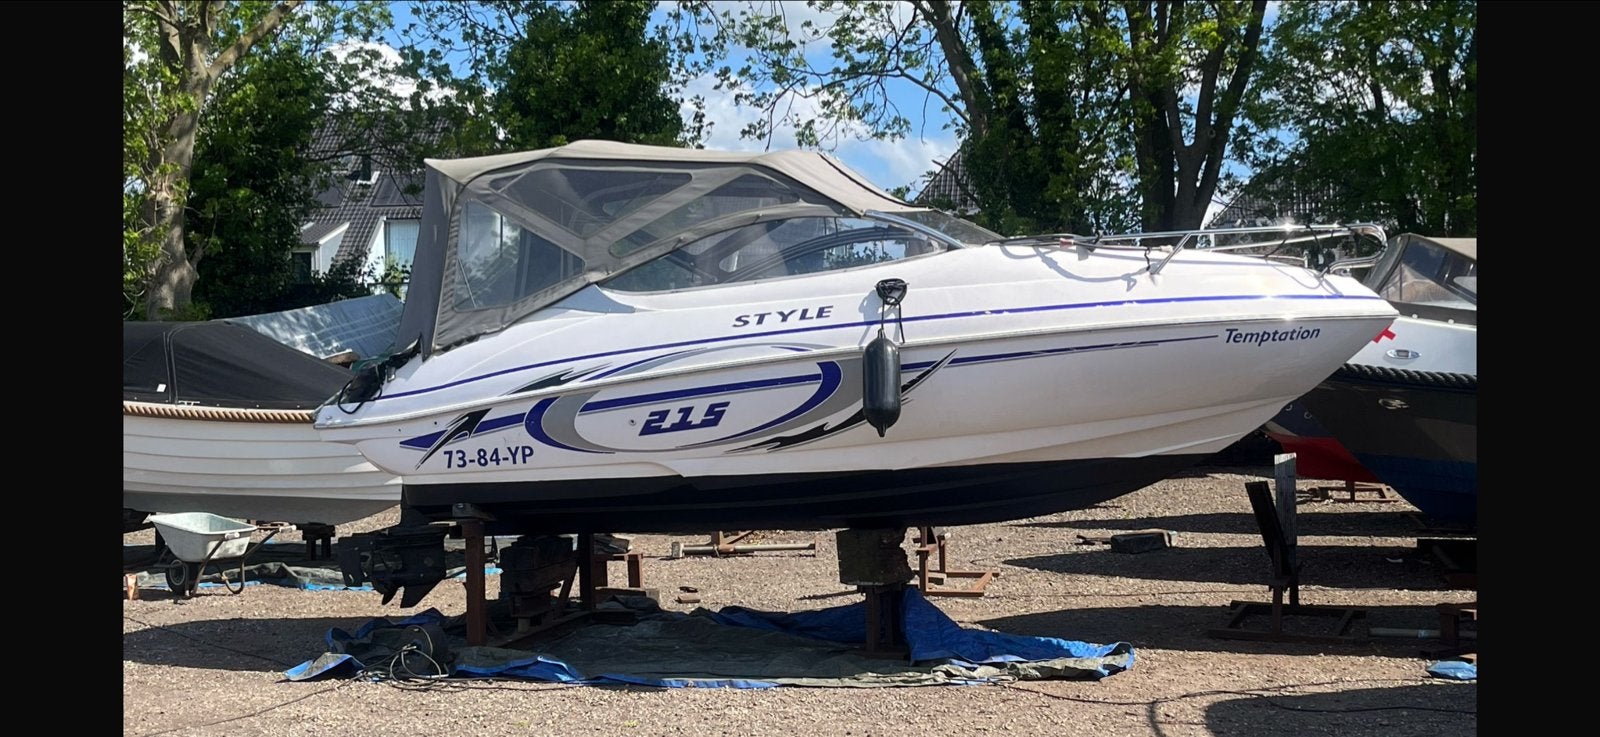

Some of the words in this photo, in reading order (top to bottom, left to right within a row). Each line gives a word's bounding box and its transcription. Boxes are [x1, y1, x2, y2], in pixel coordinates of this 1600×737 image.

[732, 305, 833, 327] STYLE
[1225, 326, 1321, 346] Temptation
[639, 401, 730, 436] 215
[443, 445, 534, 469] 73-84-YP
